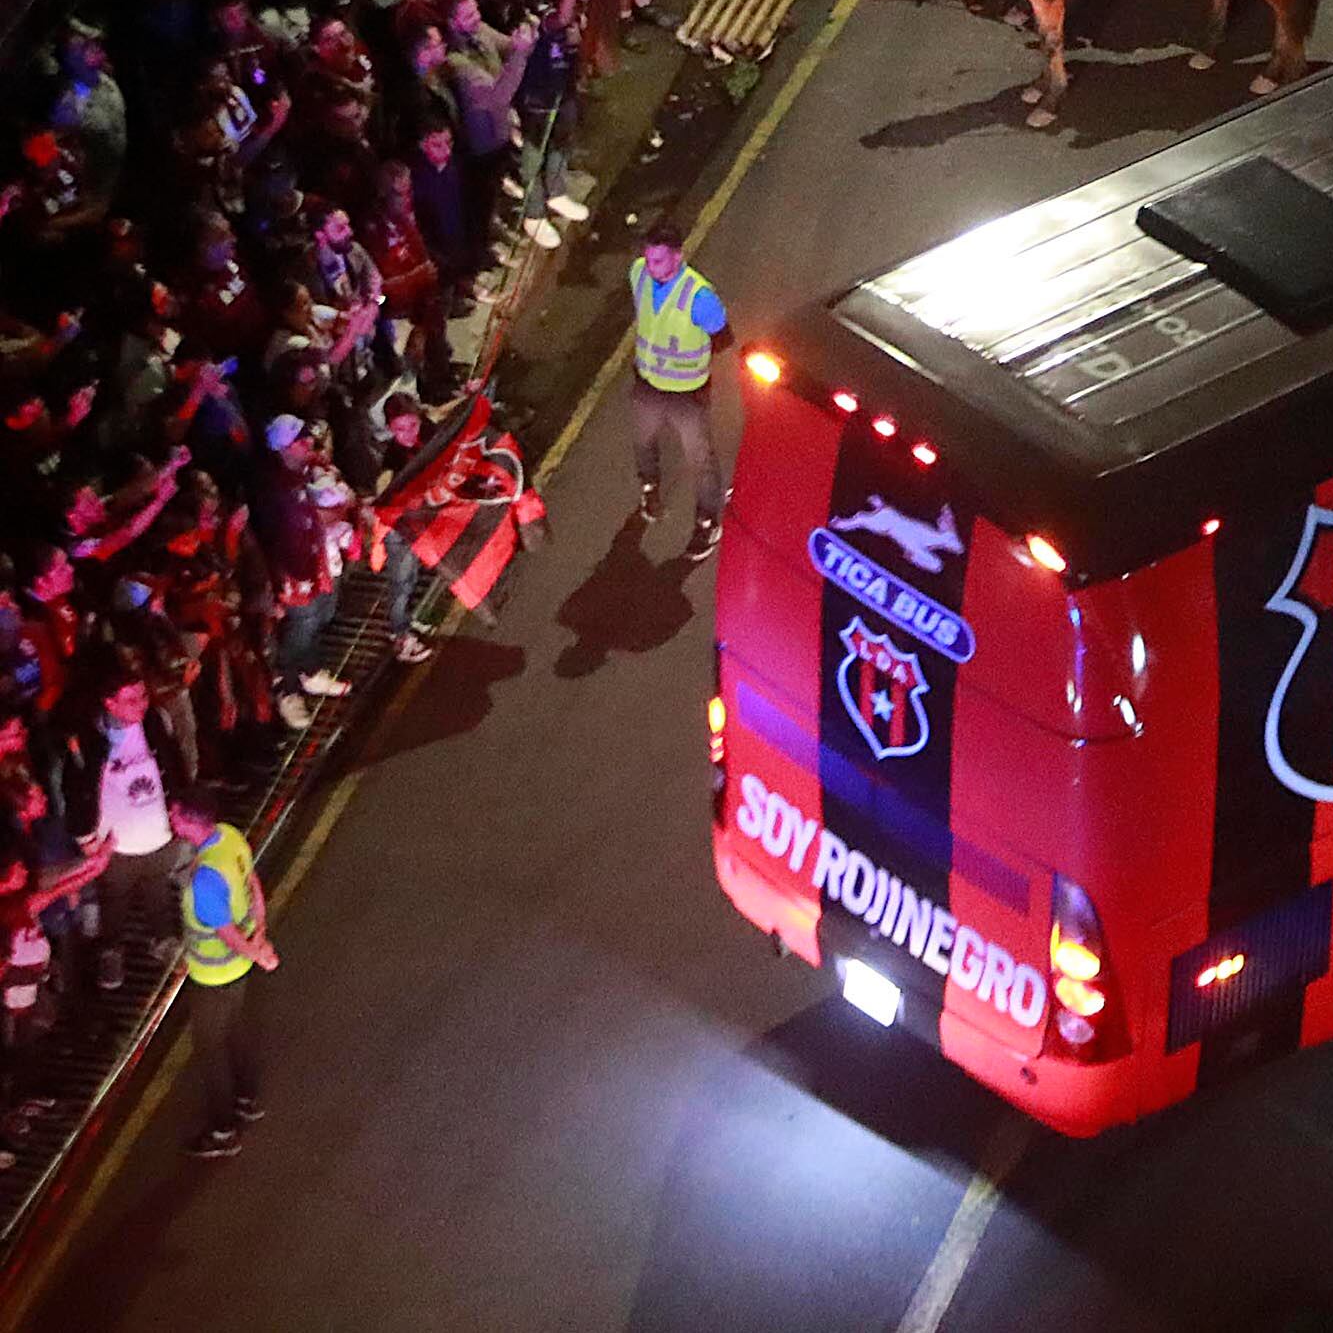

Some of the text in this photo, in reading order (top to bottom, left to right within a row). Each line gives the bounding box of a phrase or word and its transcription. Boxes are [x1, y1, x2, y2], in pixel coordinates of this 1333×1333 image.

[822, 540, 961, 648] TICA BUS
[859, 639, 909, 680] LDA
[736, 772, 1048, 1028] SOY ROJINEGRO
